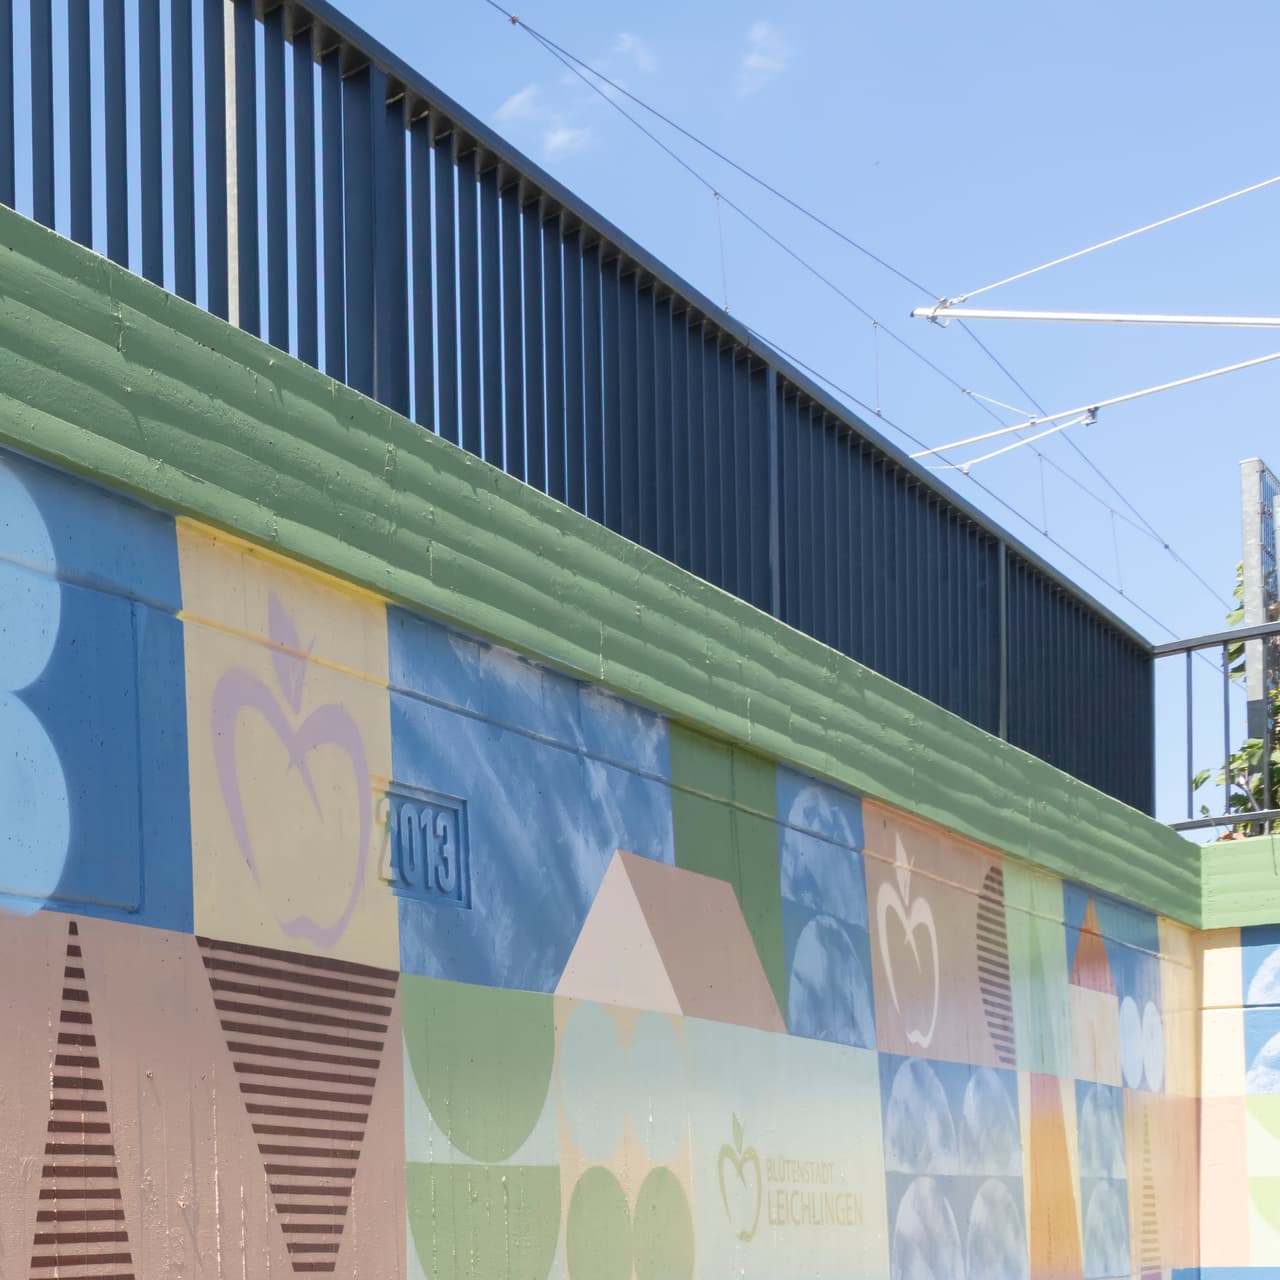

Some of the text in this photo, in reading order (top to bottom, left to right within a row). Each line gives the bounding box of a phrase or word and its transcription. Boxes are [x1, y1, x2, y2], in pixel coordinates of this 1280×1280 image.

[376, 798, 456, 893] 2013
[766, 1154, 834, 1184] BLÜTENSTADT
[768, 1190, 864, 1226] LEICHLINGEN
